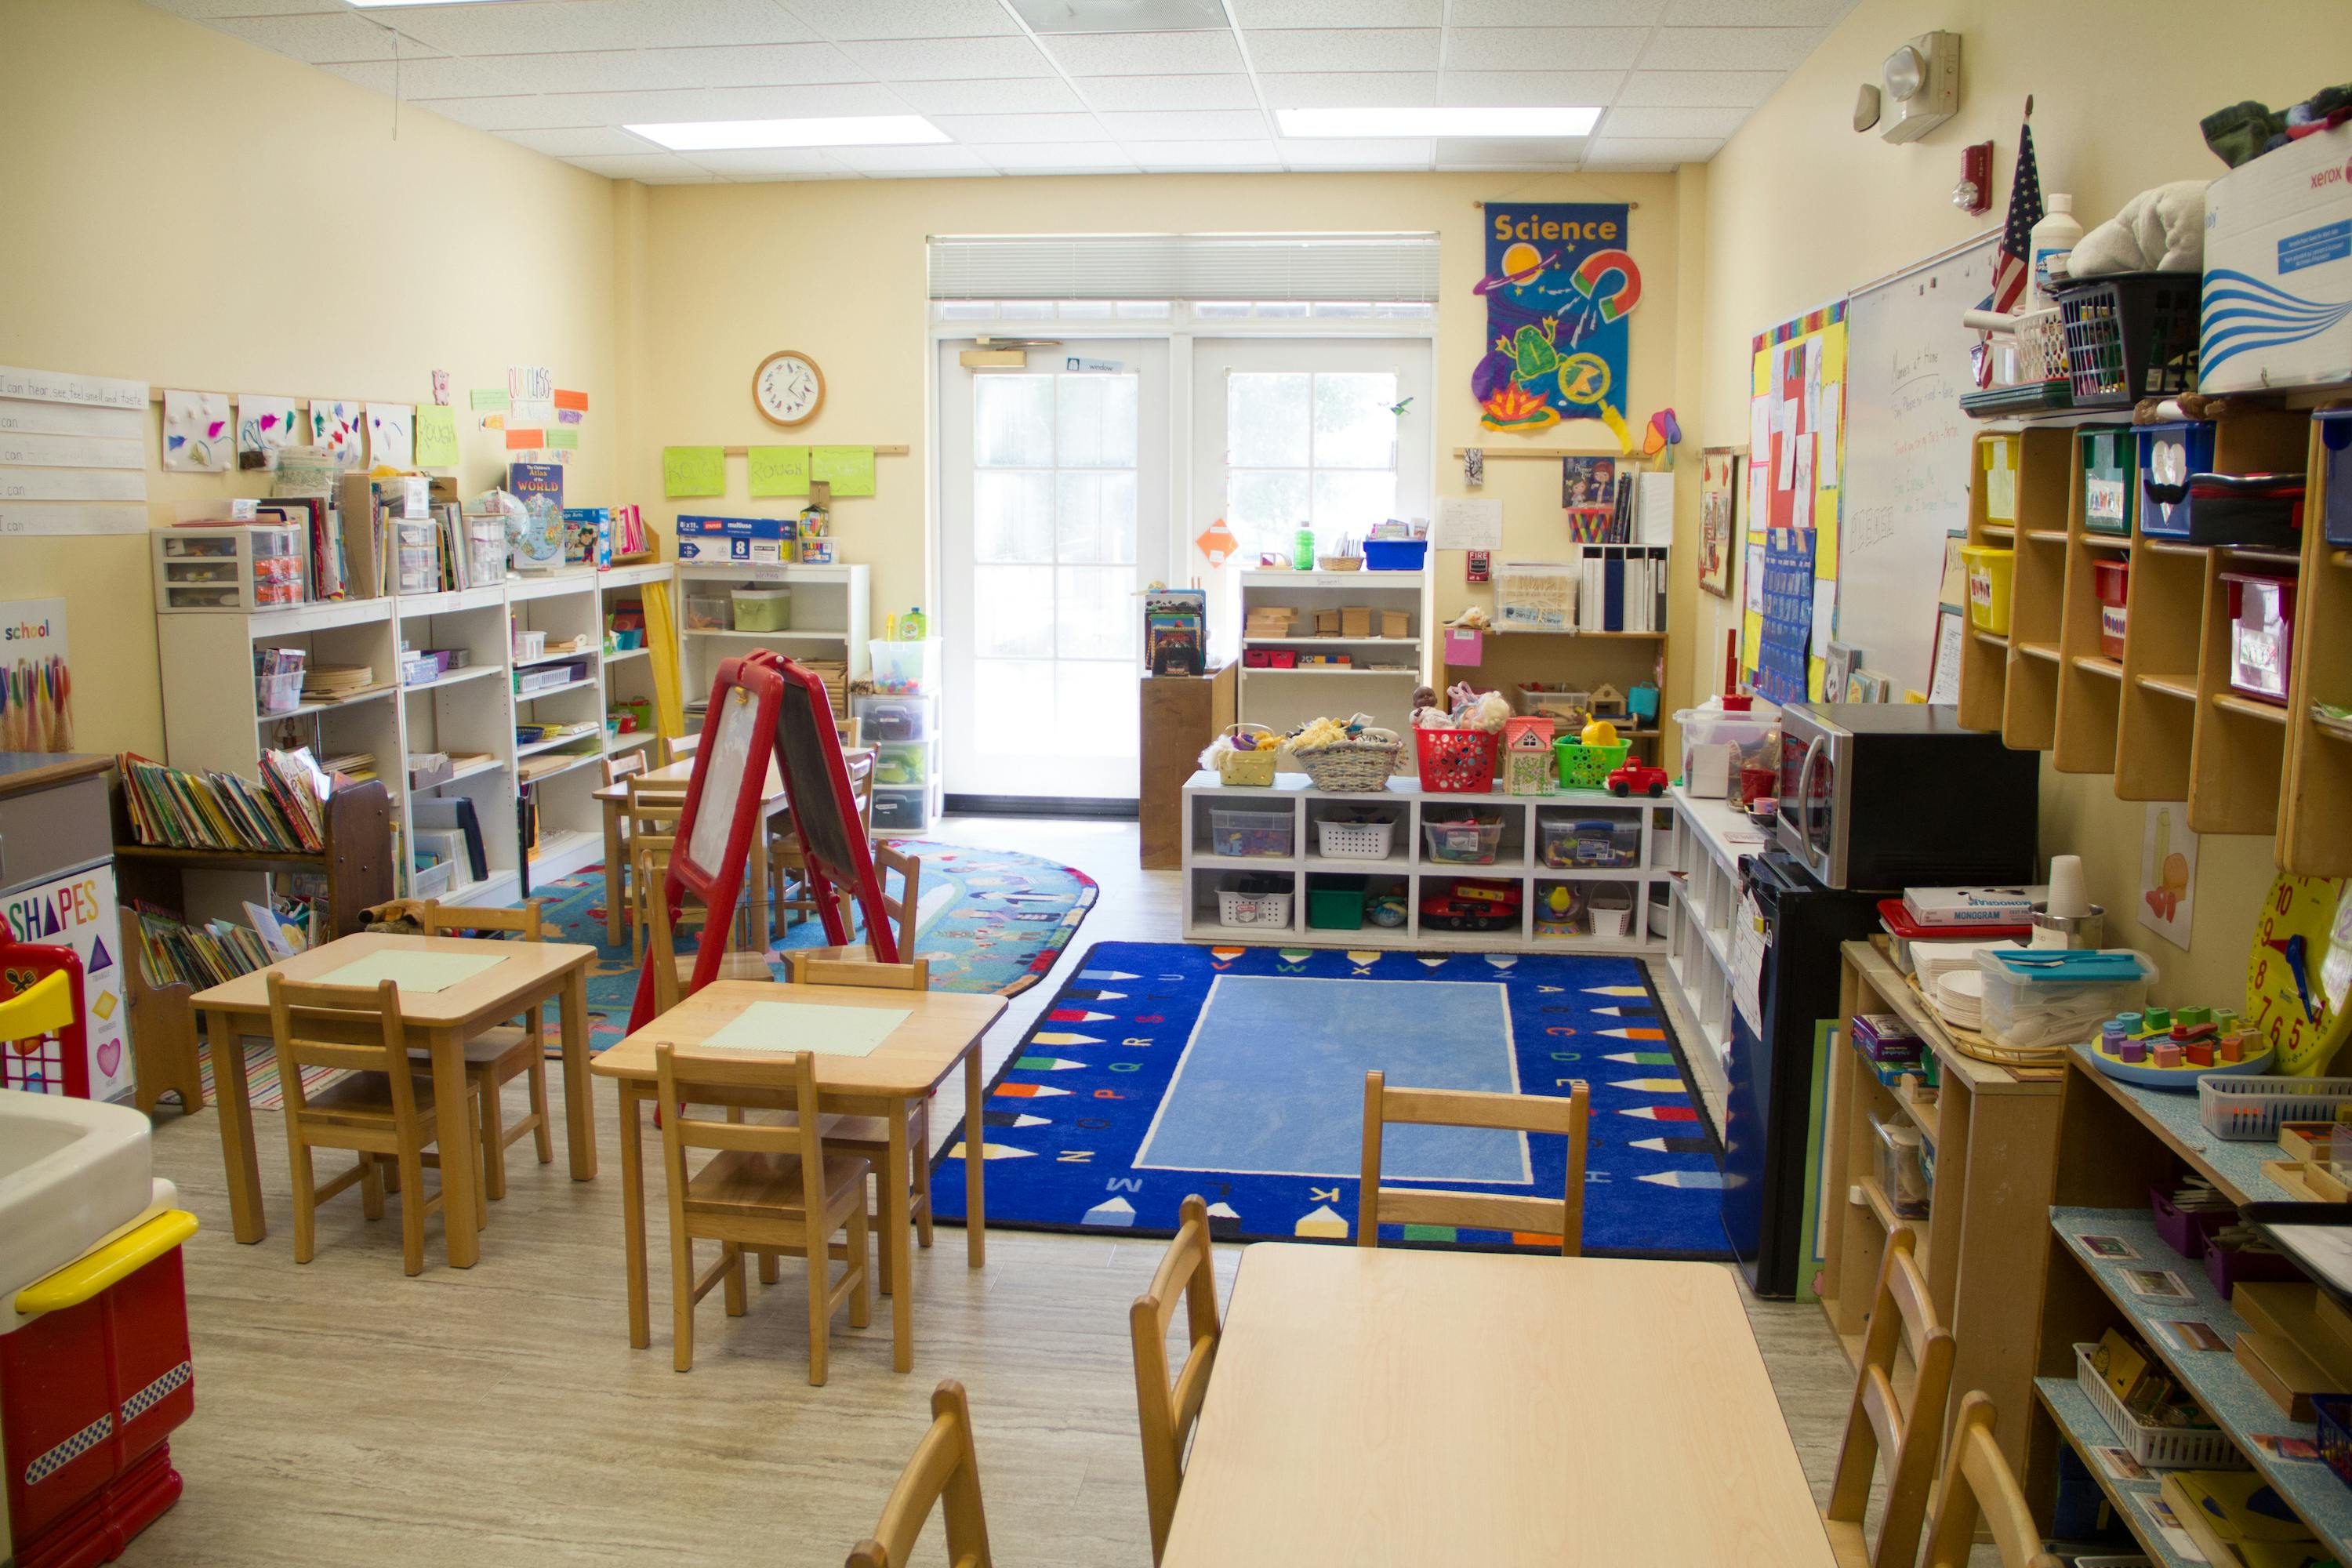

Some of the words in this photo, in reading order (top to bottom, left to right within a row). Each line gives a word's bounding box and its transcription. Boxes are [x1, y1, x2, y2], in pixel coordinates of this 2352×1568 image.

[2310, 165, 2342, 189] xerox
[1494, 214, 1617, 241] Science
[1089, 361, 1113, 371] window
[7, 383, 24, 394] can
[104, 389, 117, 403] and
[2, 418, 18, 428] can
[419, 415, 456, 454] ROUGH
[5, 451, 24, 461] can
[750, 459, 803, 485] ROUGH
[7, 485, 25, 496] can
[517, 481, 559, 492] WORLD
[7, 521, 24, 532] can
[735, 541, 746, 554] 8
[5, 619, 49, 640] school
[2276, 883, 2293, 916] 10
[1954, 911, 2000, 920] MONOGRAM
[2261, 917, 2274, 947] 9
[1210, 962, 1232, 971] V
[1276, 964, 1306, 973] W
[1352, 967, 1372, 975] X
[2255, 960, 2267, 989] 8
[1537, 985, 1565, 993] A
[2259, 996, 2272, 1026] 7
[2314, 1000, 2326, 1032] 4
[1134, 1015, 1164, 1024] S
[1546, 1027, 1577, 1036] C
[2271, 1016, 2283, 1045] 6
[2288, 1017, 2304, 1050] 5
[1122, 1037, 1154, 1047] R
[1551, 1052, 1581, 1062] D
[1109, 1062, 1144, 1072] Q
[1094, 1089, 1125, 1099] P
[1077, 1117, 1110, 1130] O
[1056, 1150, 1095, 1163] N
[1584, 1171, 1612, 1183] H
[1105, 1177, 1143, 1192] M
[1310, 1187, 1340, 1202] K
